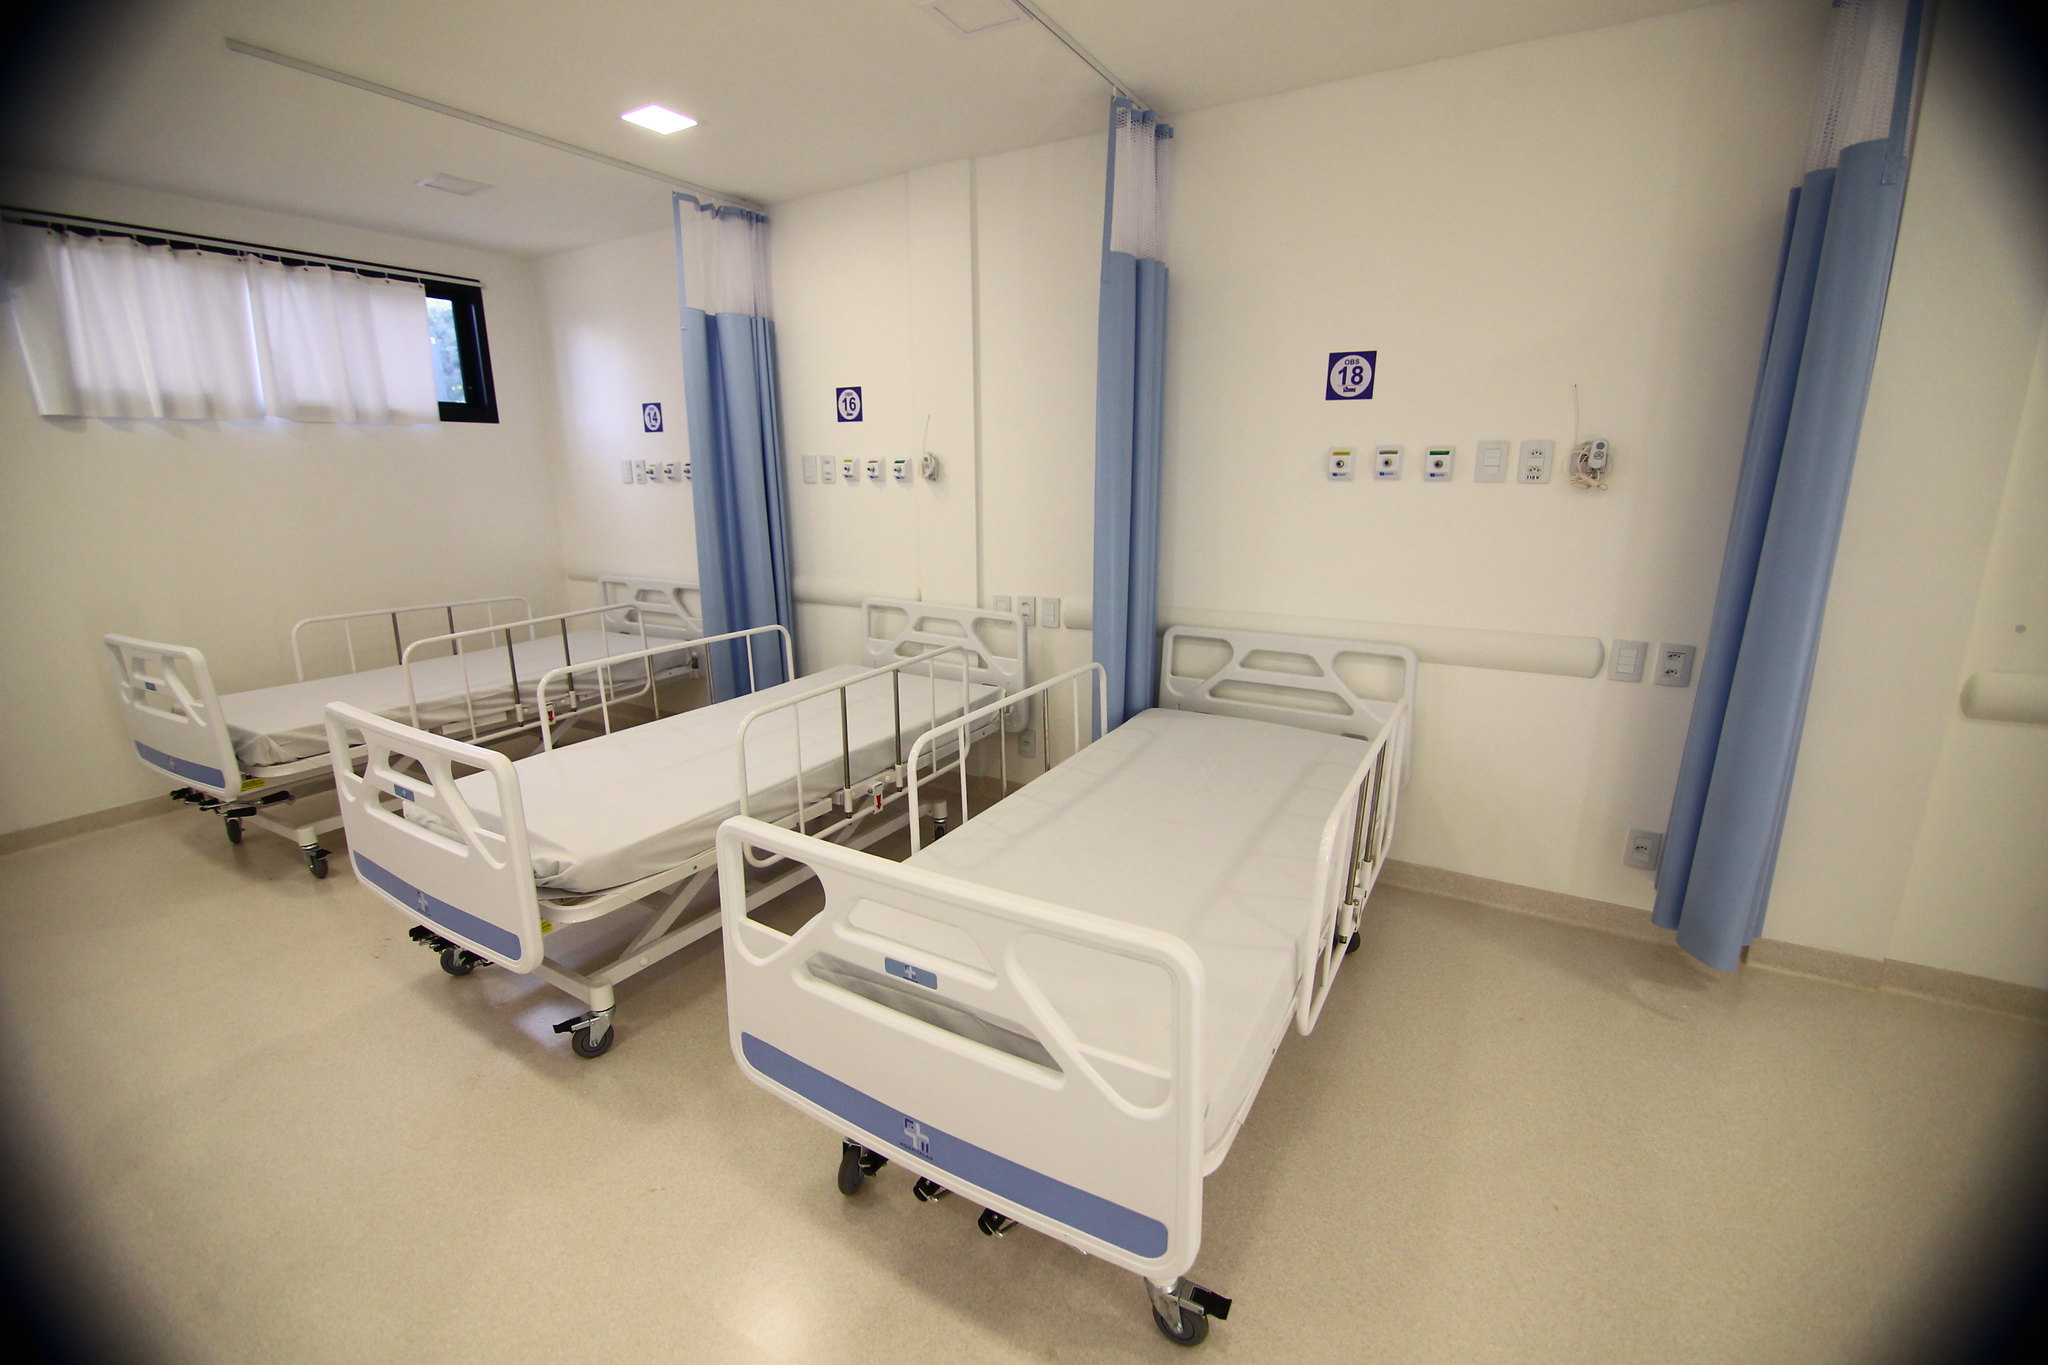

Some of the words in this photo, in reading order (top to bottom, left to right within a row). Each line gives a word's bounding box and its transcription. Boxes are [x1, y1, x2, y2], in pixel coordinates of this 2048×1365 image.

[1338, 366, 1364, 386] 18
[842, 397, 856, 411] 16
[647, 411, 658, 423] 14
